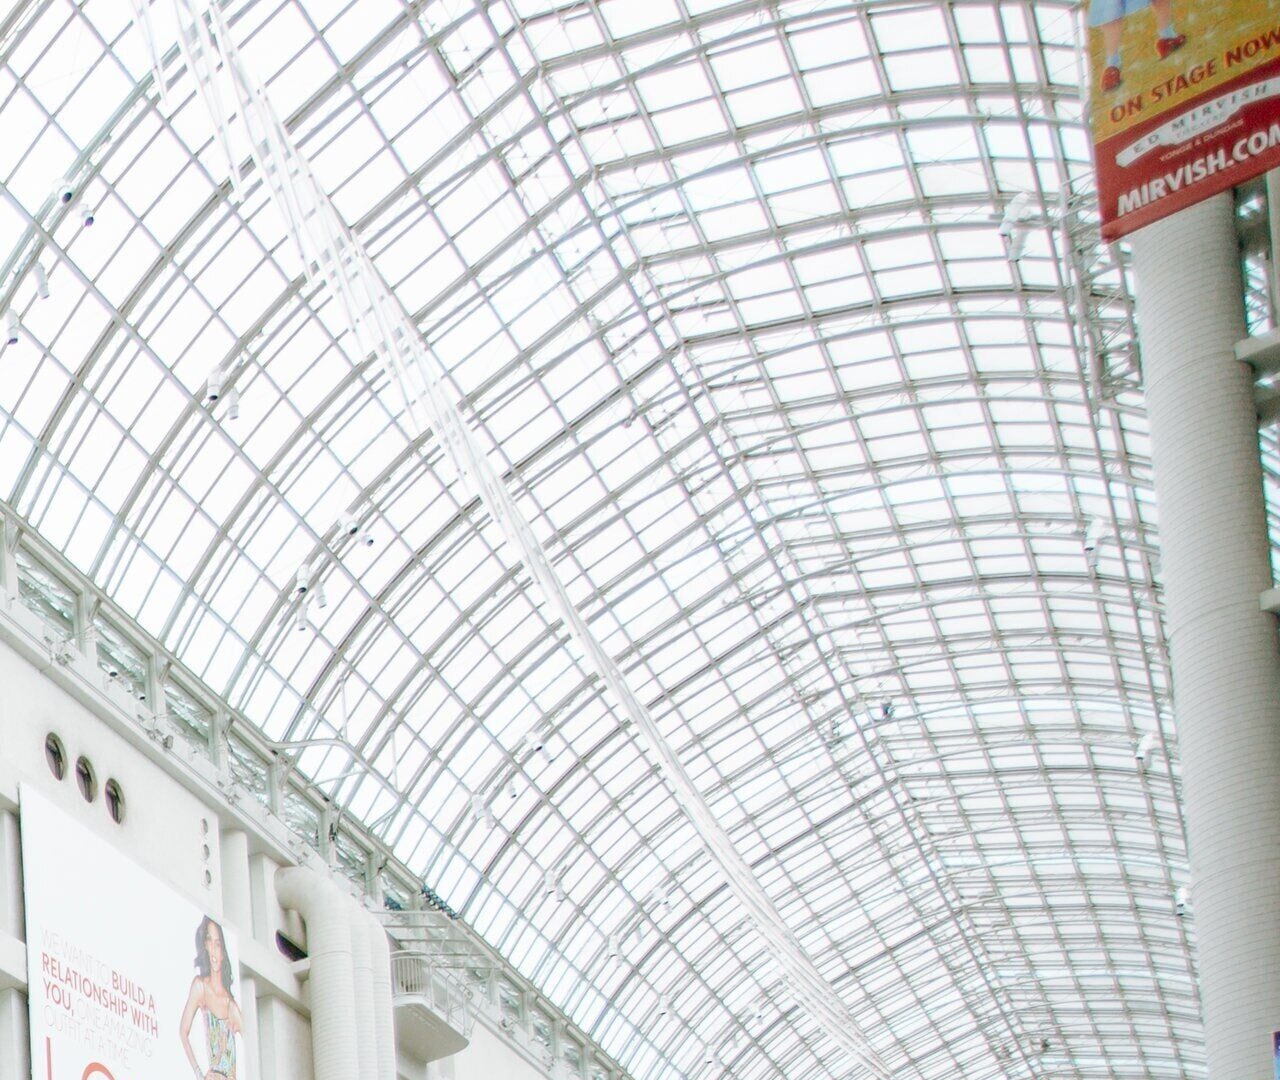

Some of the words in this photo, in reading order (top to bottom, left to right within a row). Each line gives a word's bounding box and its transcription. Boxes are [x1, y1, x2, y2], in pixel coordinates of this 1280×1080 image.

[1109, 94, 1143, 124] ON
[1150, 57, 1218, 104] STAGE
[1133, 133, 1160, 154] ED
[1171, 84, 1268, 130] MIRVISH
[42, 952, 128, 1018] RELATIONSHIP
[131, 1005, 159, 1039] WITH
[42, 978, 75, 1017] YOU,
[112, 970, 146, 1006] BUILD
[148, 994, 156, 1014] A
